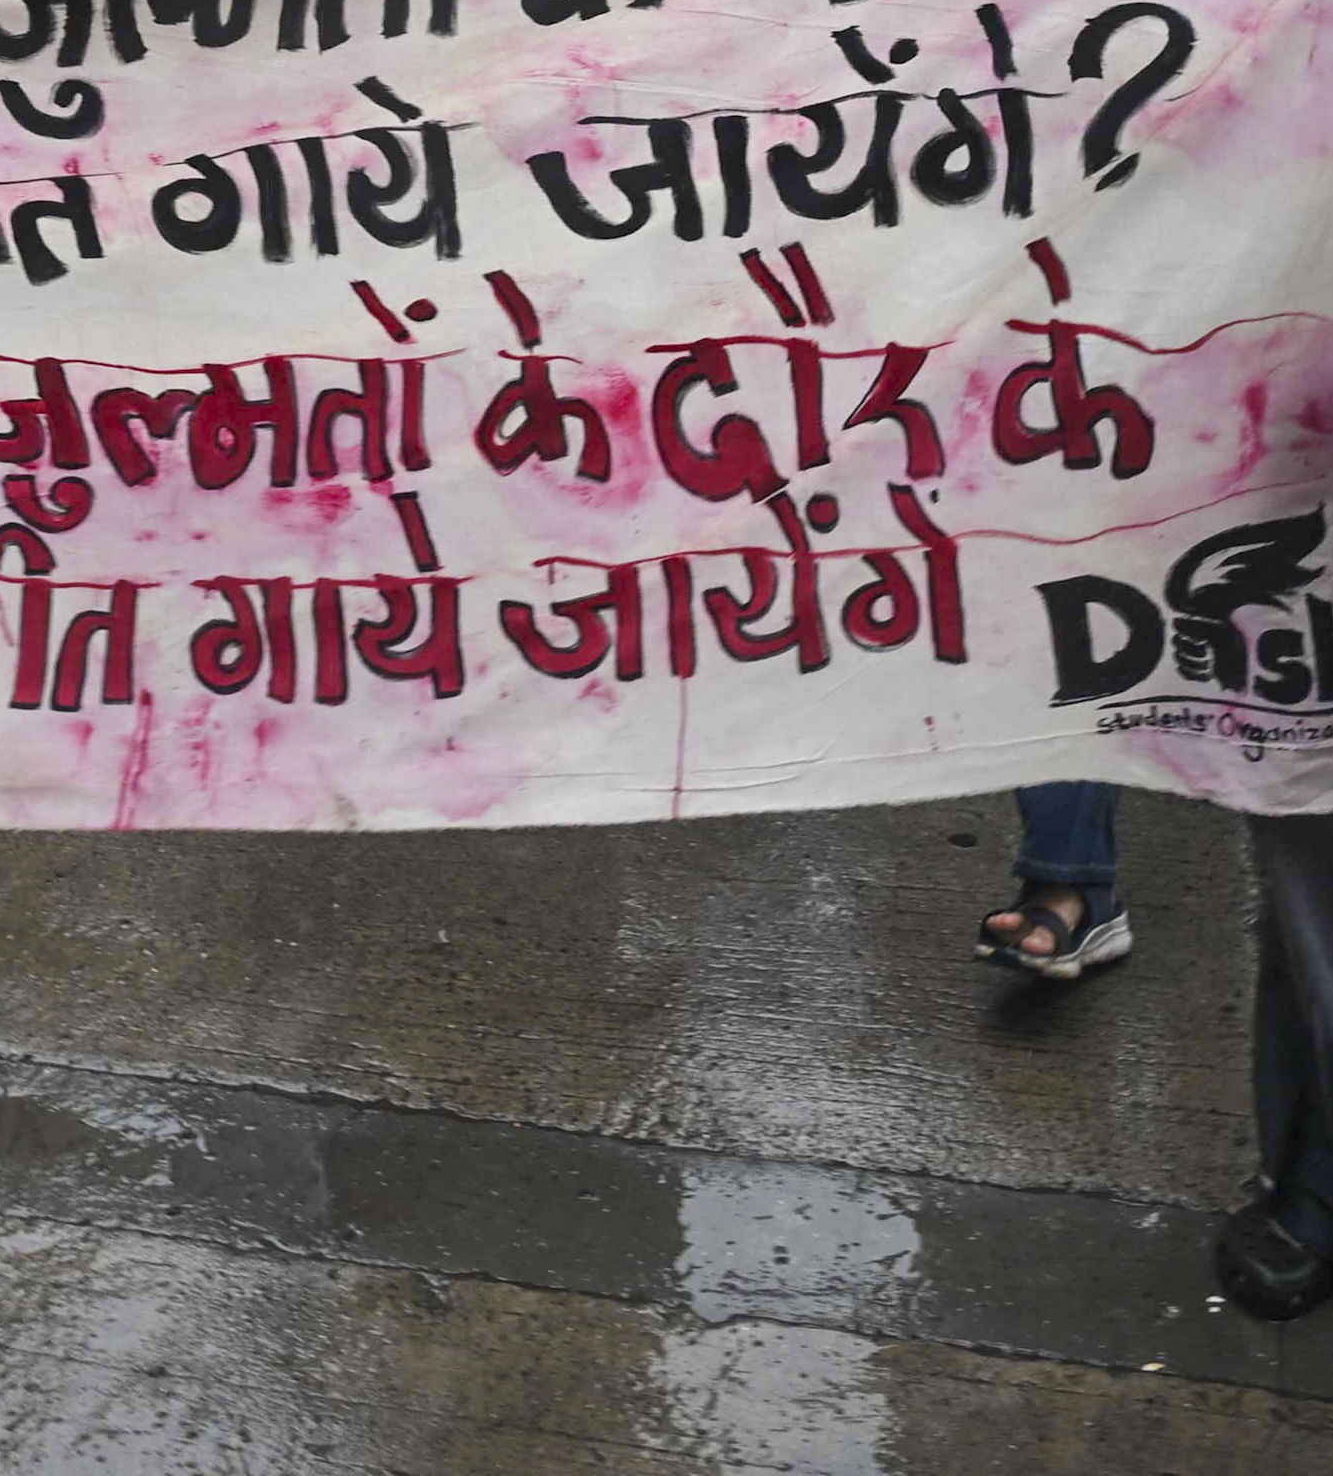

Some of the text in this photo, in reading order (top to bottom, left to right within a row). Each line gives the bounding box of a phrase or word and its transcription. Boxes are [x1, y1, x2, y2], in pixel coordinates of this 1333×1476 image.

[152, 76, 468, 262] गाये
[474, 270, 612, 483] के
[647, 242, 950, 504] दौर
[992, 237, 1158, 480] के
[190, 492, 470, 704] गाये
[499, 483, 970, 684] जायेंगे
